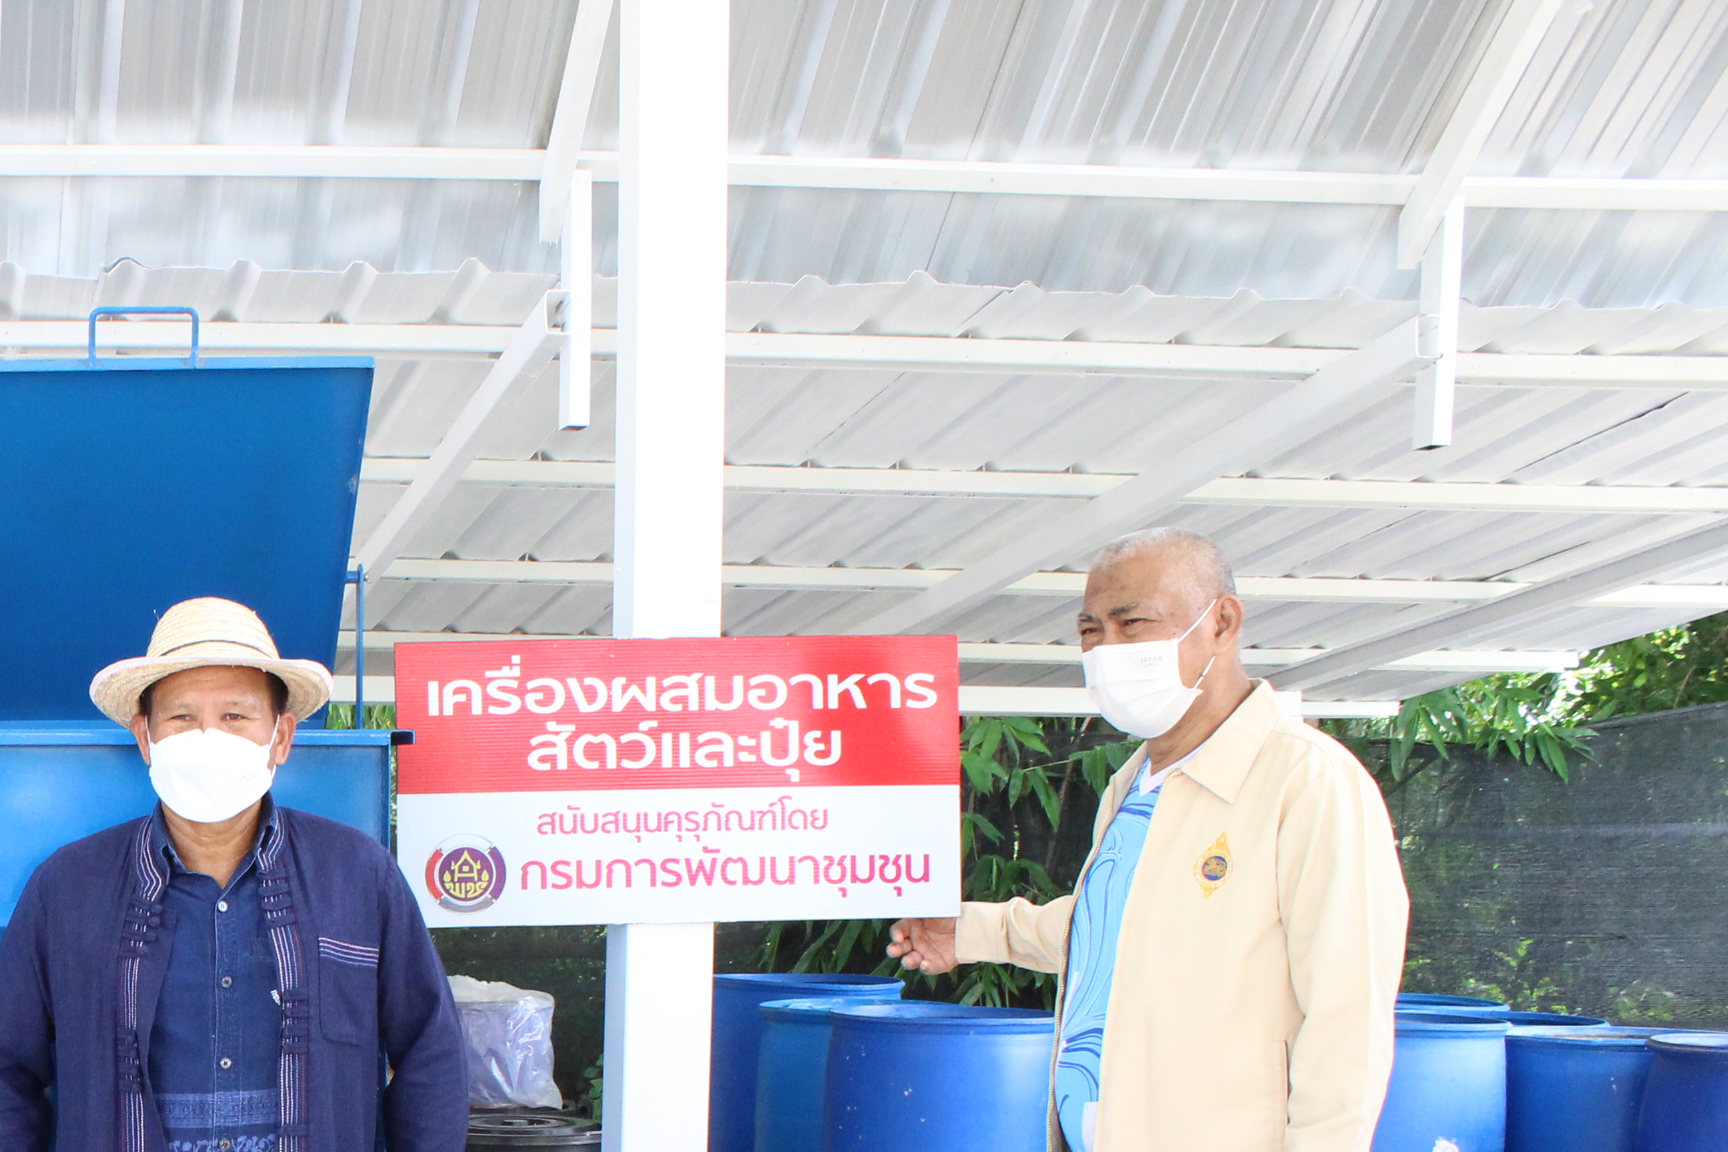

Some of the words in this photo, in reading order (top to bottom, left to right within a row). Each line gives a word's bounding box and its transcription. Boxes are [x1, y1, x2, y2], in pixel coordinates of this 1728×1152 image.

[427, 654, 939, 717] เครื่องผสมอาหาร
[527, 717, 843, 783] สัตว์และปุ๋ย
